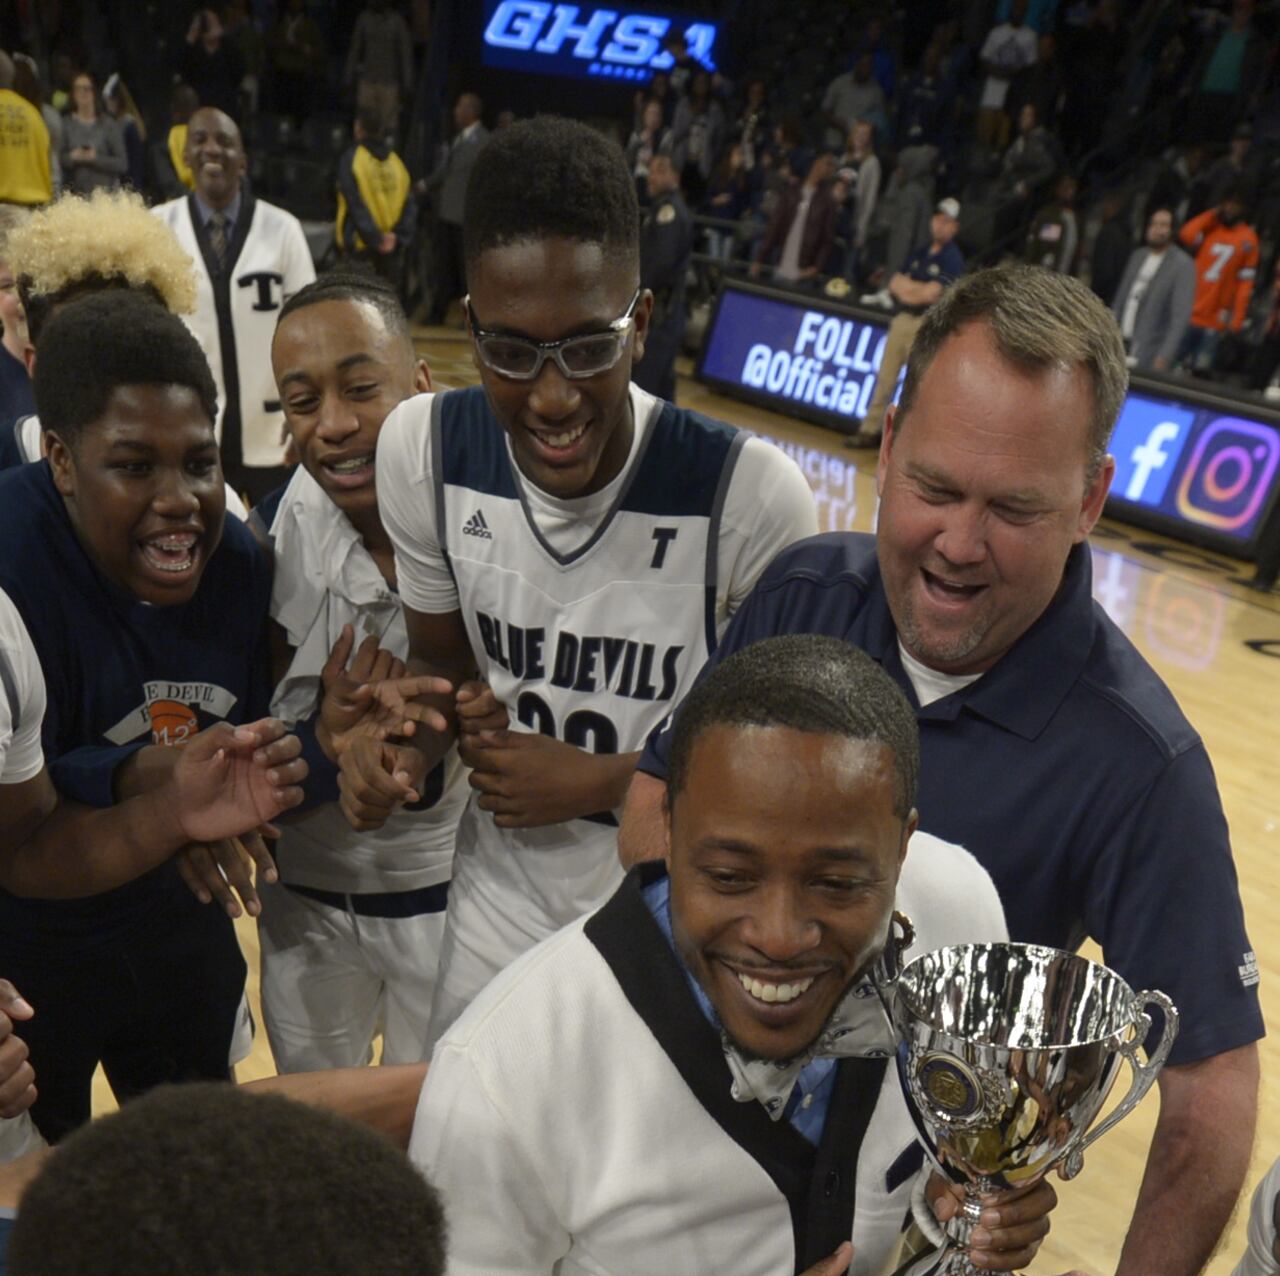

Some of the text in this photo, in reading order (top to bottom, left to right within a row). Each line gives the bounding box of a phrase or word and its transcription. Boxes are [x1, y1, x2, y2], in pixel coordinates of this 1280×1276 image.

[1204, 243, 1234, 282] 7
[238, 271, 283, 312] T
[650, 527, 679, 569] T
[475, 609, 686, 701] BLUE DEVILS
